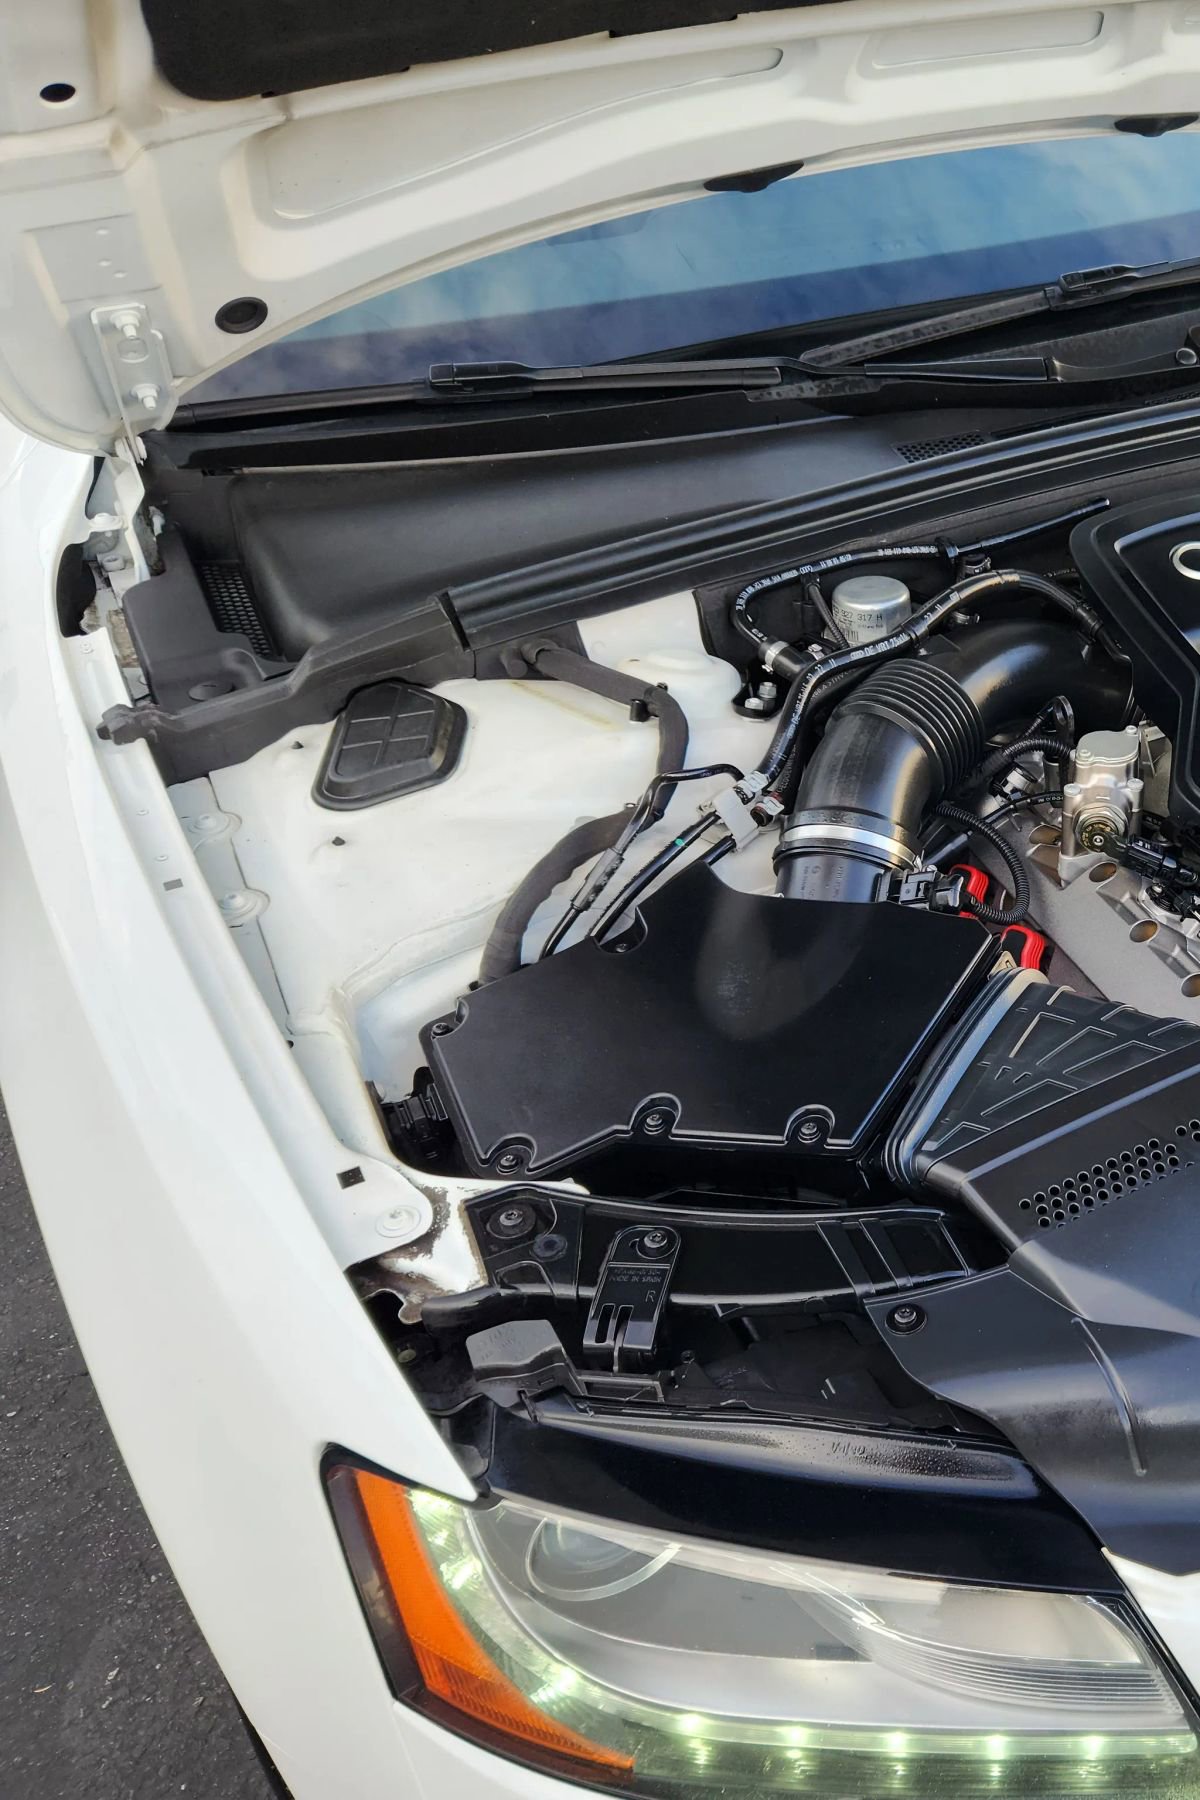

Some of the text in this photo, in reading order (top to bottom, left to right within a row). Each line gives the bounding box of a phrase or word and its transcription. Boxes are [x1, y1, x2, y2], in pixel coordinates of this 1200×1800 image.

[857, 613, 873, 622] 317
[876, 613, 883, 621] H
[645, 1290, 656, 1302] R
